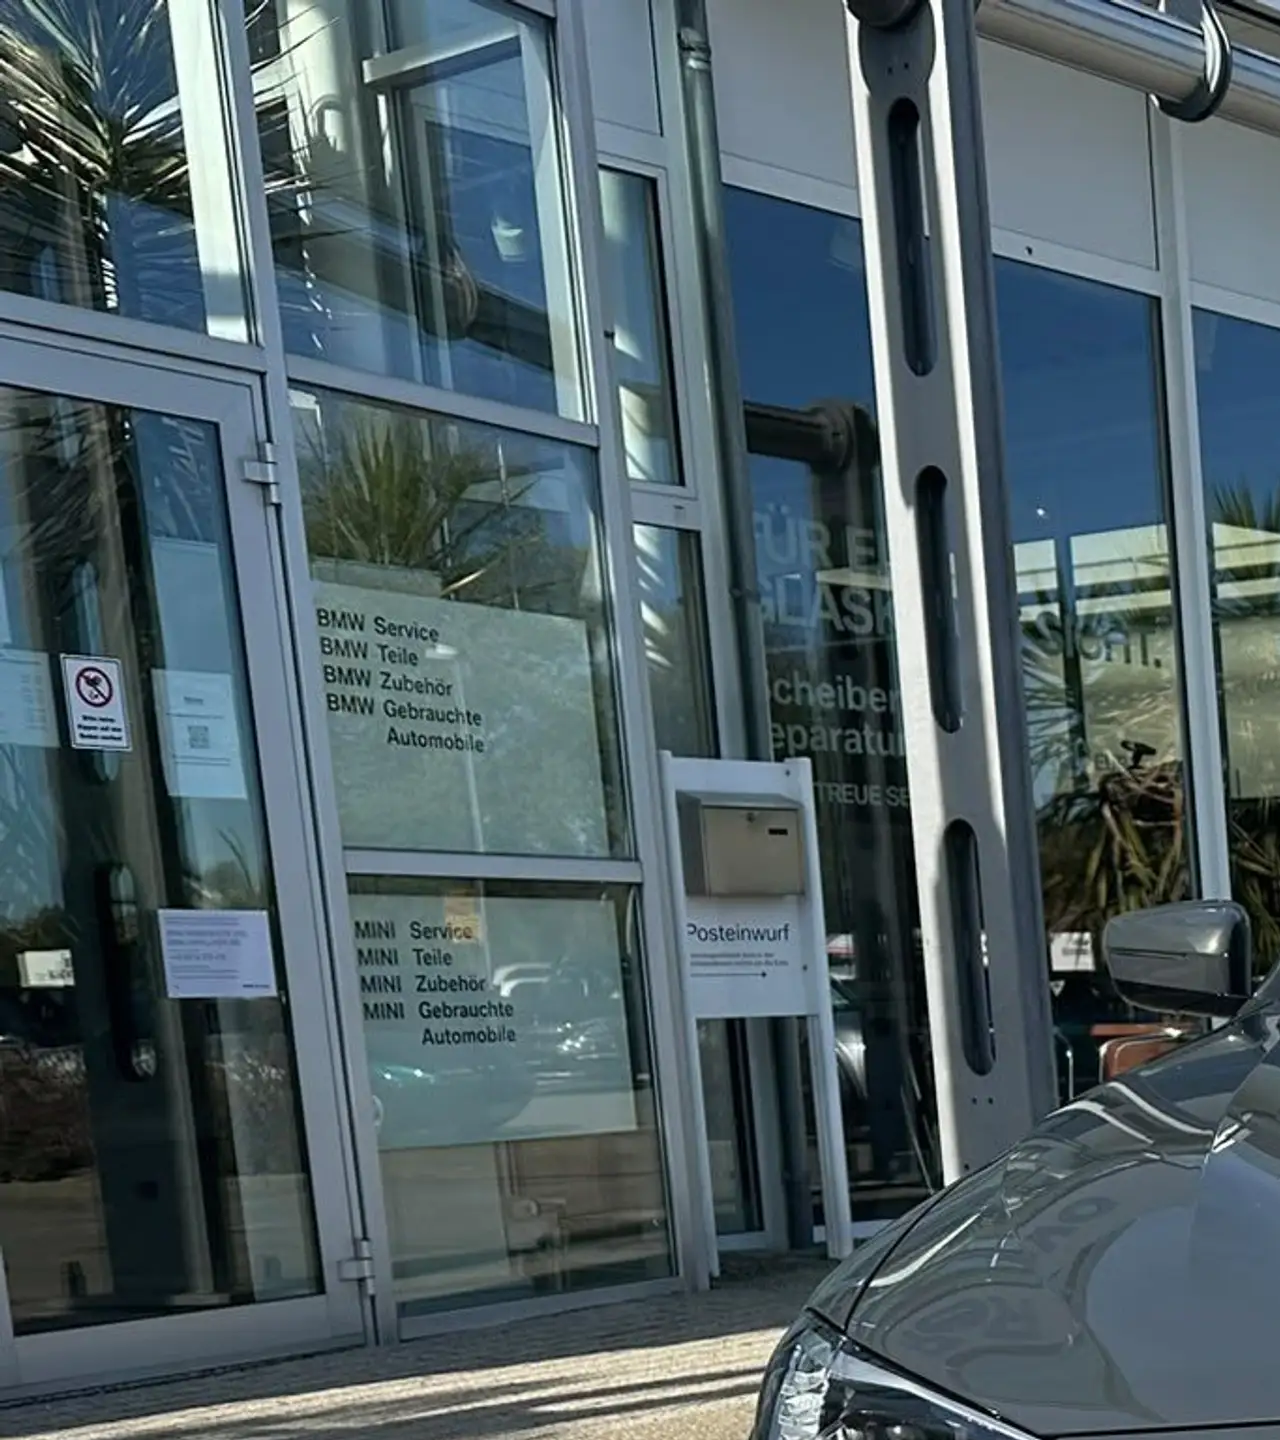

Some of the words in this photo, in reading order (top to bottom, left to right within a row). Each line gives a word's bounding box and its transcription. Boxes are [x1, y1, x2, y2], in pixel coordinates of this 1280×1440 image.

[317, 608, 365, 632] BMW
[374, 616, 439, 643] Service
[320, 637, 368, 660] BMW
[377, 643, 419, 666] Teile
[323, 665, 371, 688] BMW
[380, 671, 453, 696] Zubehör
[326, 693, 375, 715] BMW
[383, 699, 482, 726] Gebrauchte
[387, 726, 485, 753] Automobile
[813, 782, 882, 806] TREUE
[354, 920, 396, 940] MINI
[409, 921, 473, 940] Service
[686, 922, 790, 942] Posteinwurf
[358, 948, 399, 966] MINI
[412, 948, 453, 966] Teile
[360, 975, 402, 993] MINI
[415, 974, 487, 993] Zubehör
[363, 1002, 405, 1020] MINI
[418, 1000, 514, 1020] Gebrauchte
[422, 1026, 516, 1046] Automobile
